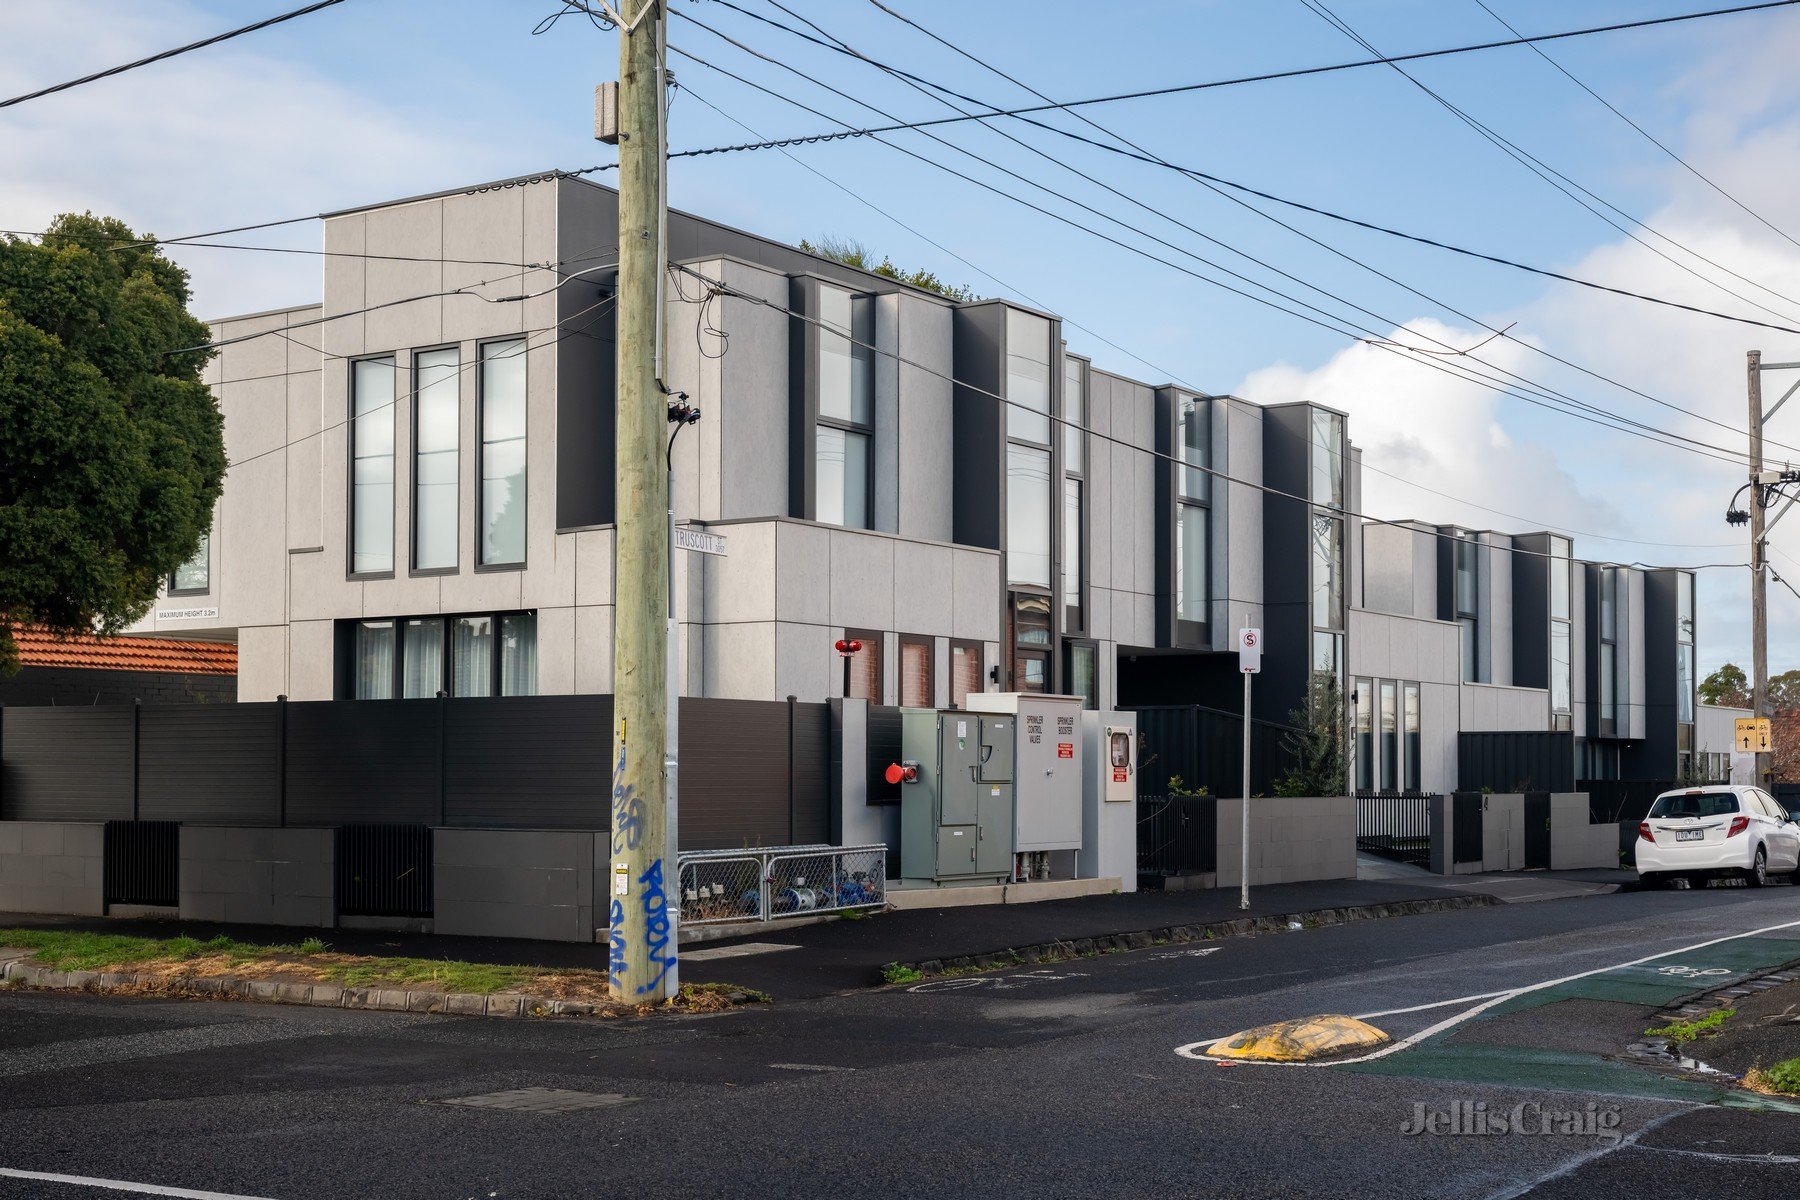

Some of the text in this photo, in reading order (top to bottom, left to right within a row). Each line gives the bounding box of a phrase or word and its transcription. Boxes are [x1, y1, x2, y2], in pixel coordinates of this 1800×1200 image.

[675, 530, 712, 550] TRUSCOTT
[1246, 634, 1254, 645] S
[1026, 715, 1043, 724] SPRINKLER
[1057, 716, 1074, 725] SPRINKLER
[1027, 725, 1042, 734] CONTROL
[1058, 726, 1073, 735] BOOSTER
[1029, 735, 1041, 744] VALVES
